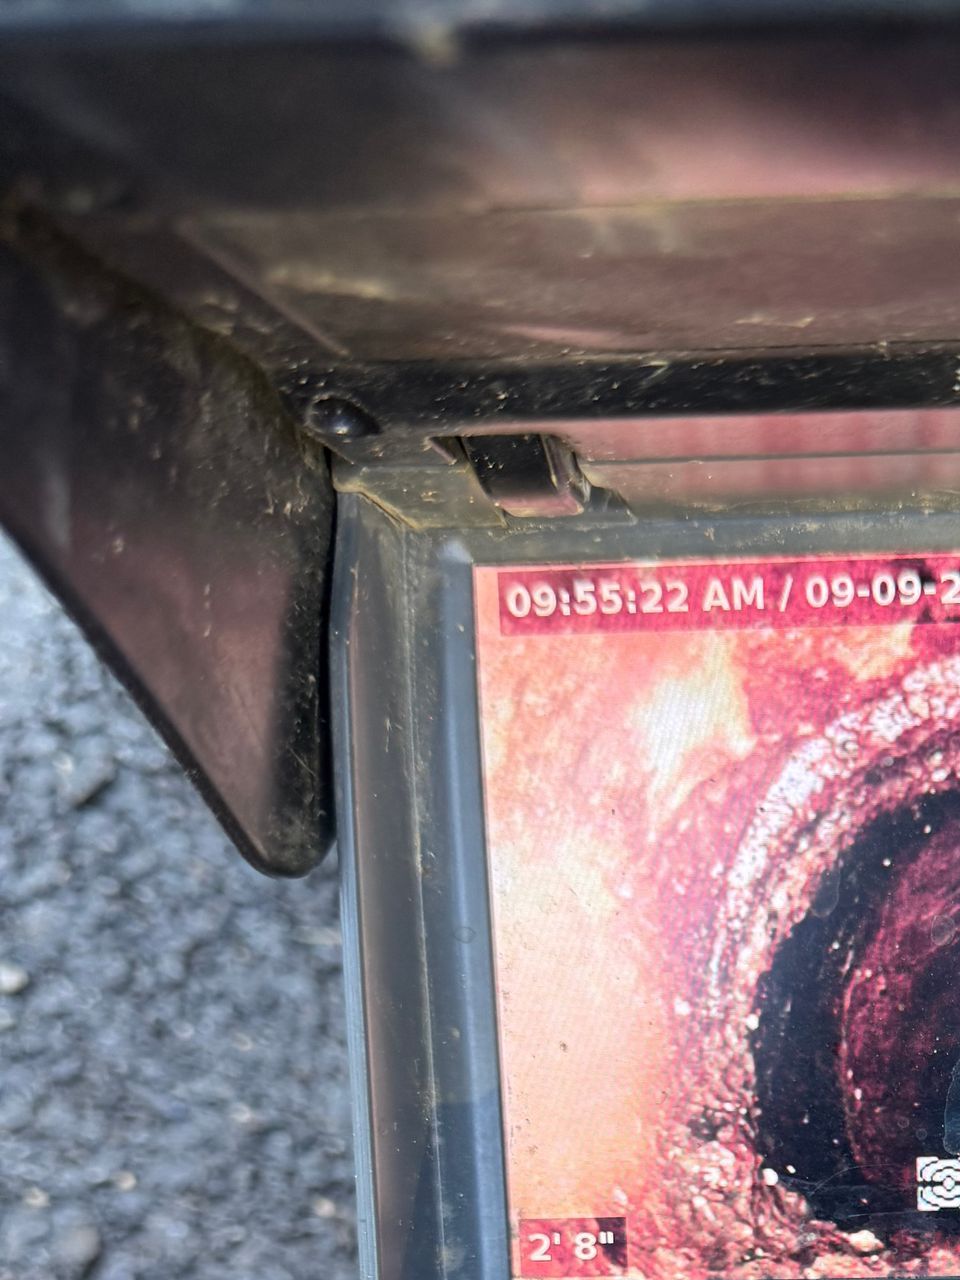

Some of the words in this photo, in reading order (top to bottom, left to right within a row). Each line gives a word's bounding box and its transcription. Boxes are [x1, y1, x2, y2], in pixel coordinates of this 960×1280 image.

[506, 579, 690, 618] 09:55:22
[702, 577, 765, 611] AM
[778, 576, 793, 613] /
[527, 1232, 561, 1262] 2'
